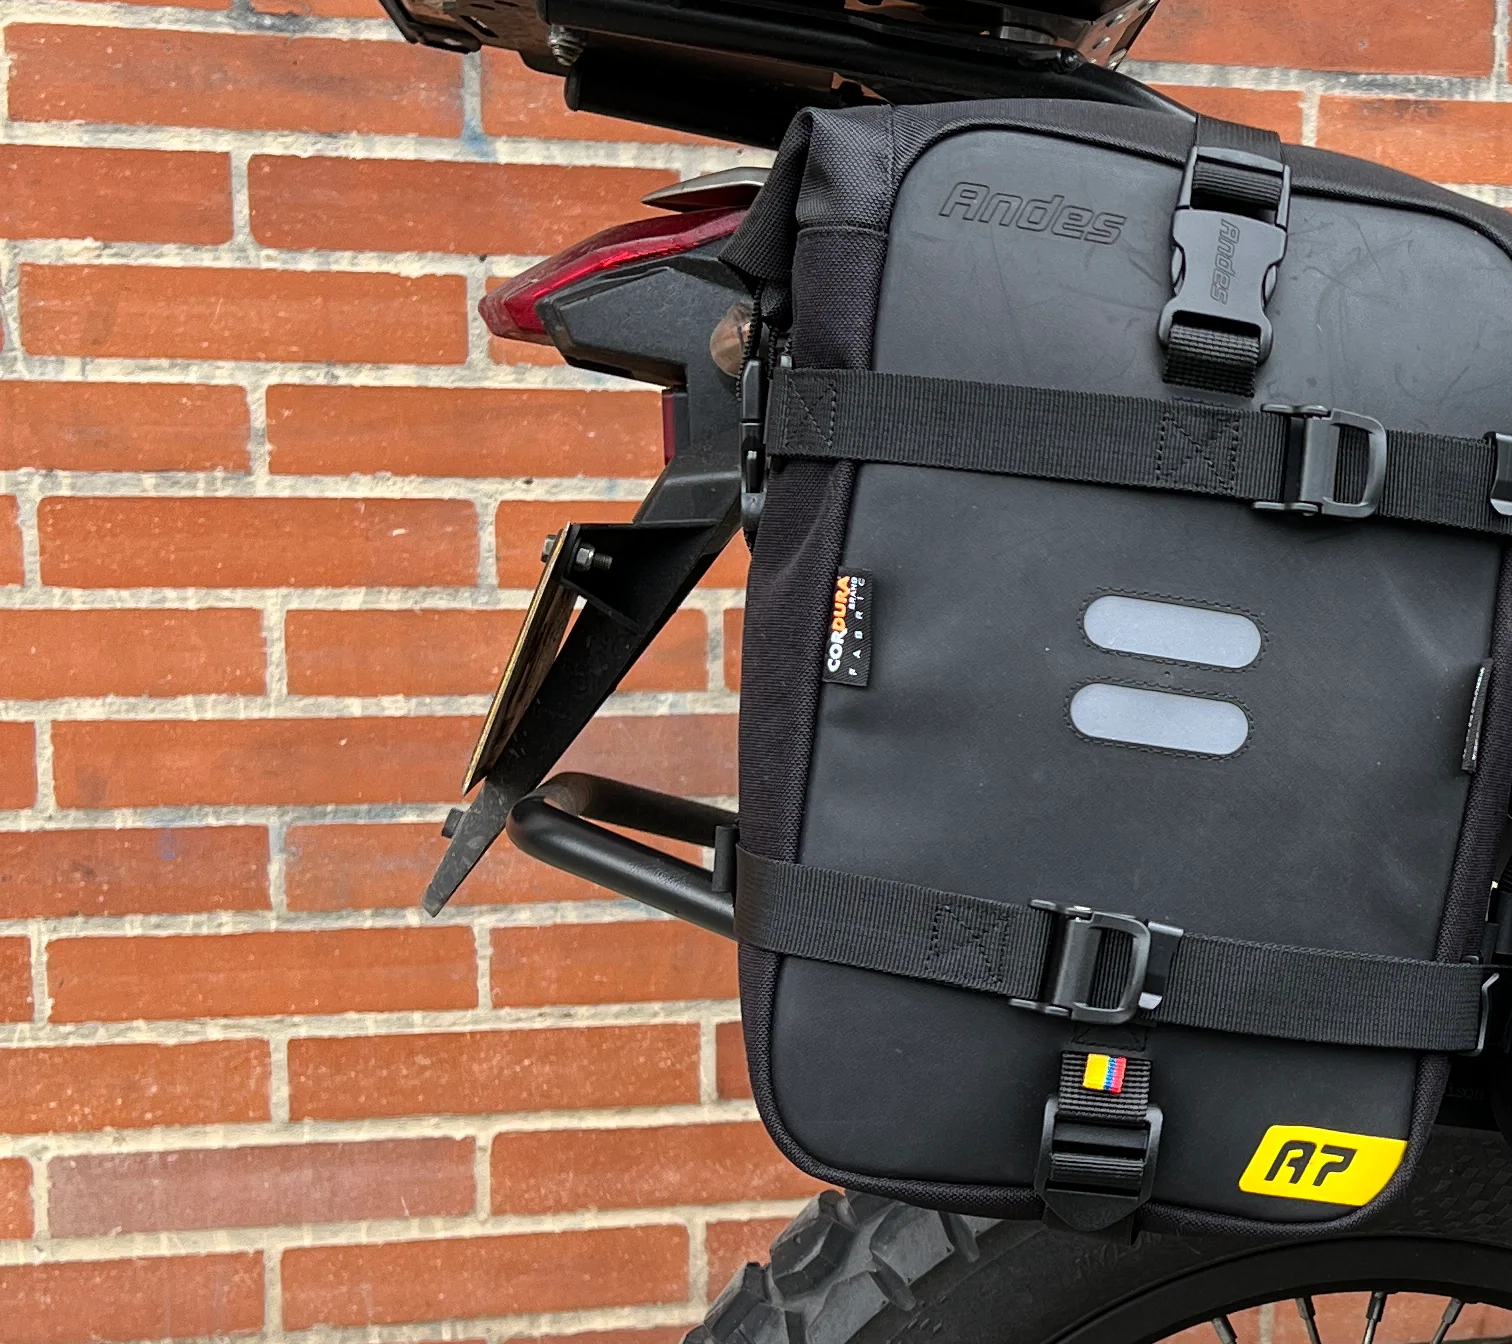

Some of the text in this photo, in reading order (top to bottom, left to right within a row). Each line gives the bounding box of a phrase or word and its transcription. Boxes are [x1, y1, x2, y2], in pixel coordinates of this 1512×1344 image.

[939, 182, 1127, 245] Andes
[1210, 219, 1240, 304] Andes
[828, 576, 858, 672] CORDURA BRAND
[1446, 1081, 1484, 1101] ison
